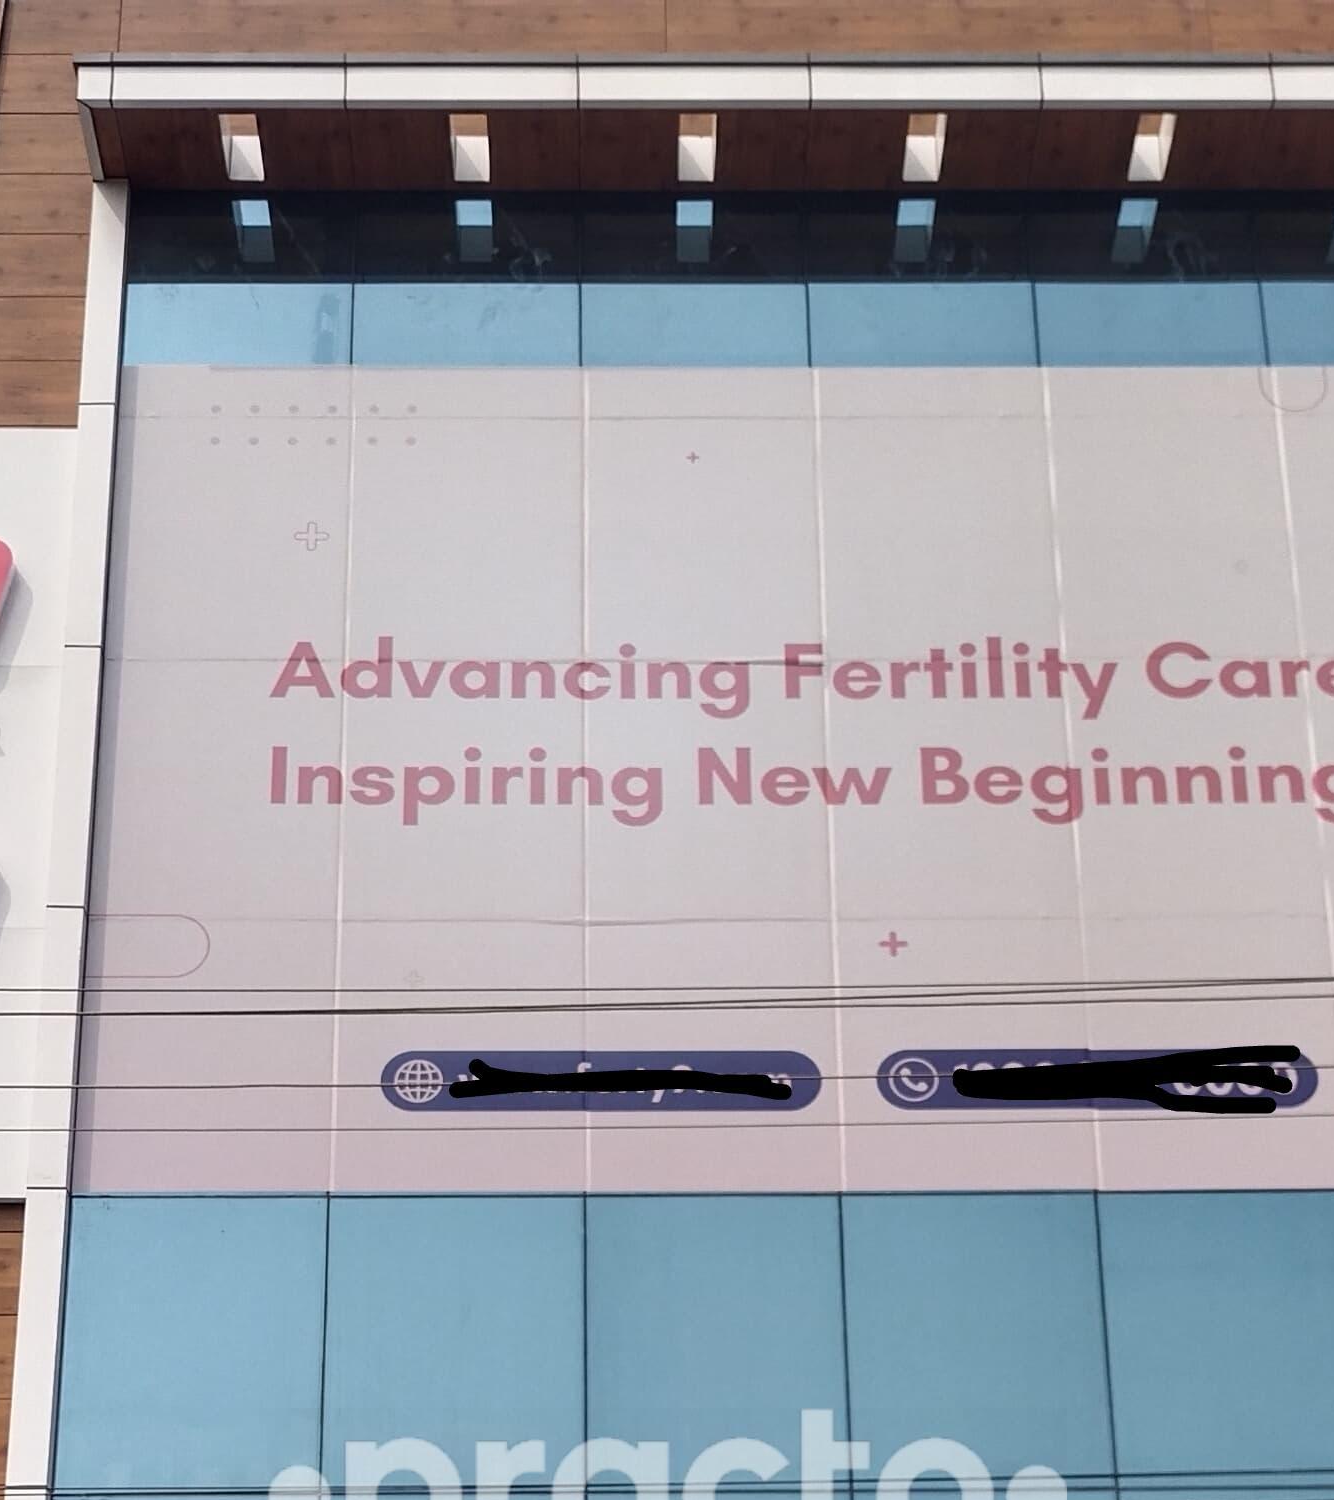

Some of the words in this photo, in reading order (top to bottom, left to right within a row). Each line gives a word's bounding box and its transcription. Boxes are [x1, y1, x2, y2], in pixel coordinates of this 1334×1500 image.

[269, 637, 752, 719] Advancing
[785, 637, 1117, 720] Fertility
[269, 746, 664, 826] Inspiring
[696, 747, 891, 806] New
